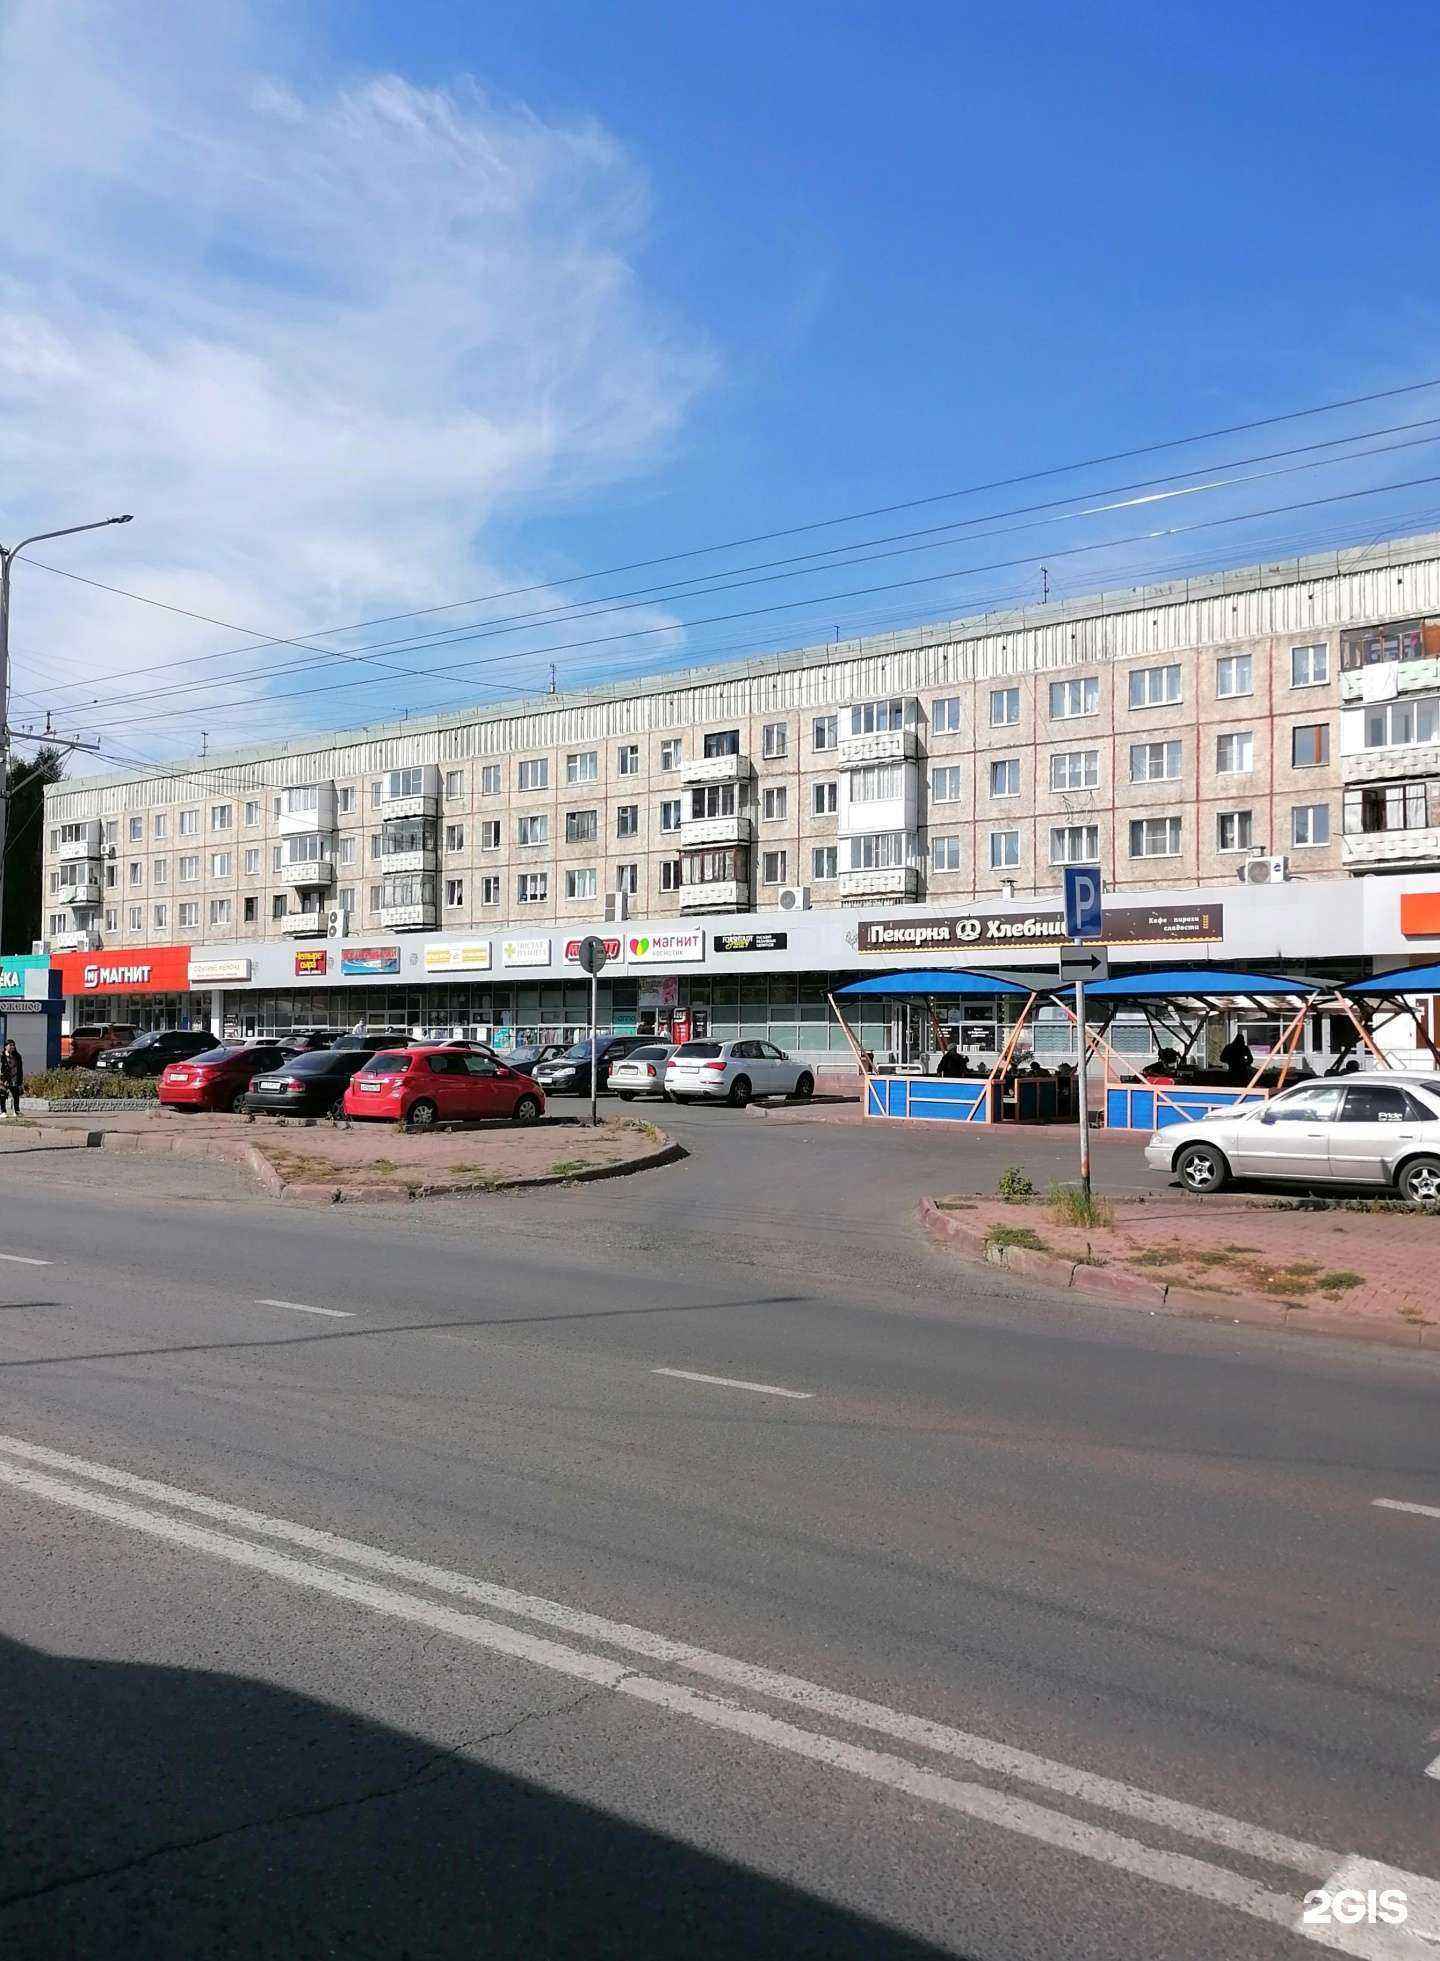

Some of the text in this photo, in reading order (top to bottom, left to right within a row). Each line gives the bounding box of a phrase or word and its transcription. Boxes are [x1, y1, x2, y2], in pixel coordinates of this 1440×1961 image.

[1074, 876, 1095, 929] P
[870, 925, 950, 945] Пекарня
[100, 965, 152, 984] МАГНИТ
